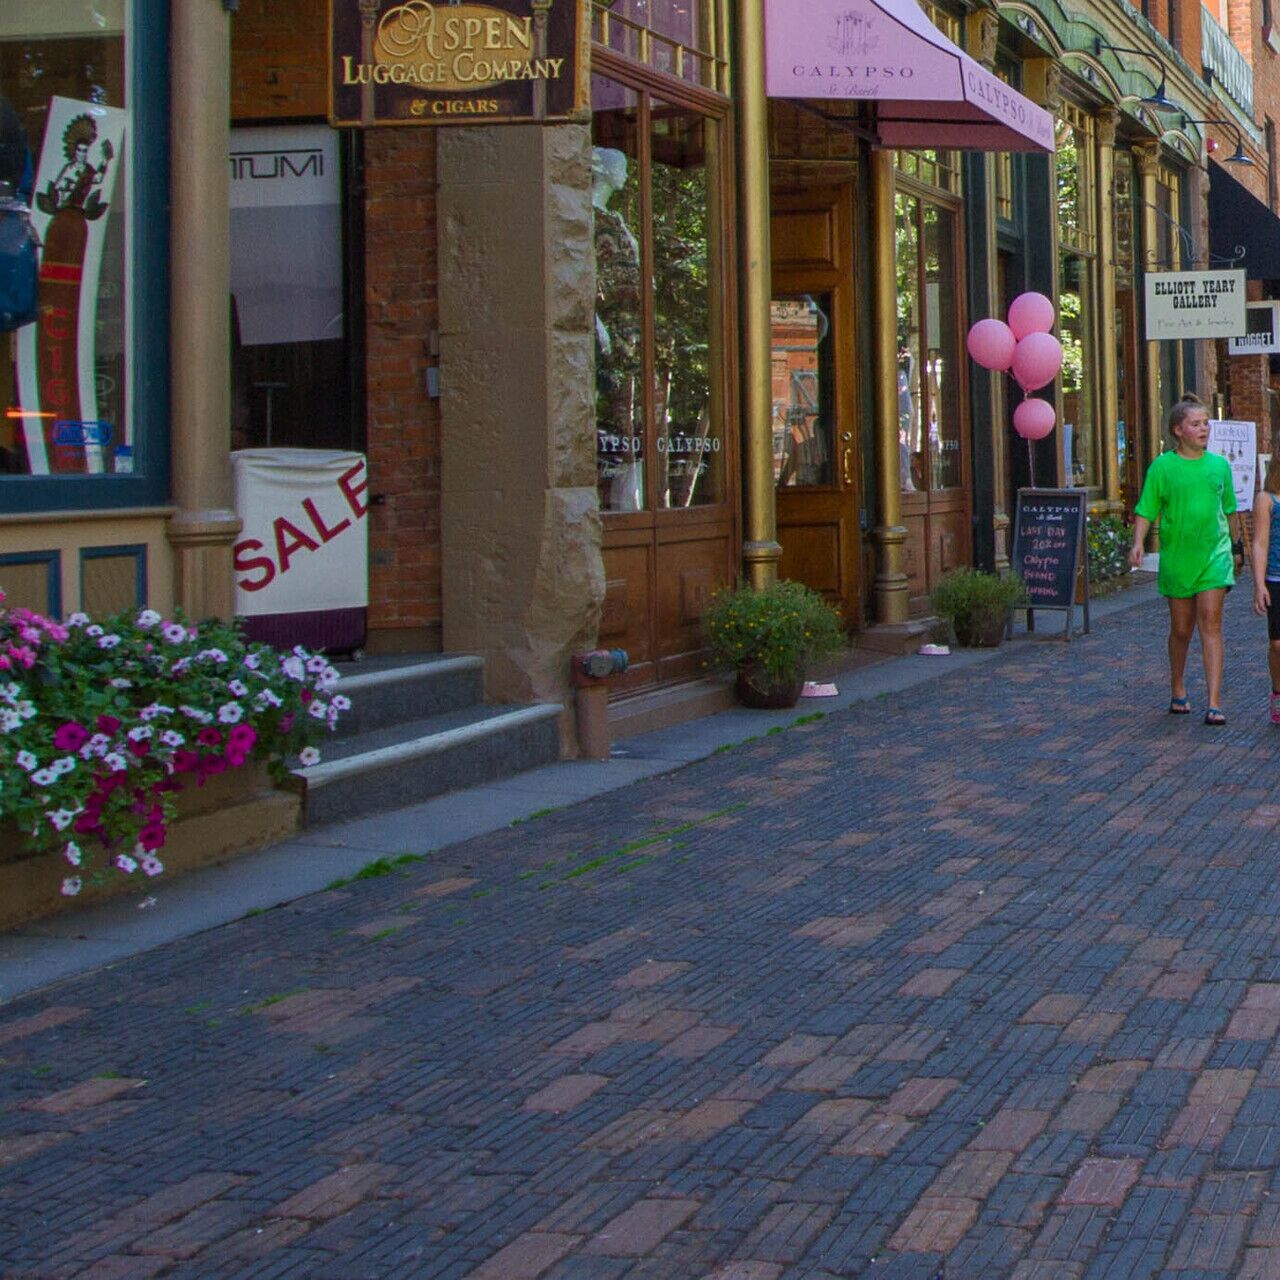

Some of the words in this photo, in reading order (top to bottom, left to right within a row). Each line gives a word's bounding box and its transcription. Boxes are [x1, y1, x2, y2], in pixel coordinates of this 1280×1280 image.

[378, 0, 534, 60] ASPEN
[341, 55, 446, 85] LUGGAGE
[453, 53, 565, 82] COMPANY
[792, 65, 915, 79] CALYPSO
[968, 71, 1027, 125] CALYPSO
[409, 99, 429, 116] &
[432, 99, 499, 115] CIGARS
[1155, 281, 1196, 295] ELLIOTT
[1202, 279, 1236, 294] YEARY
[1173, 295, 1218, 309] GALLERY
[600, 436, 641, 452] YPSO
[656, 436, 721, 452] CALYPSO
[233, 460, 369, 592] SALE
